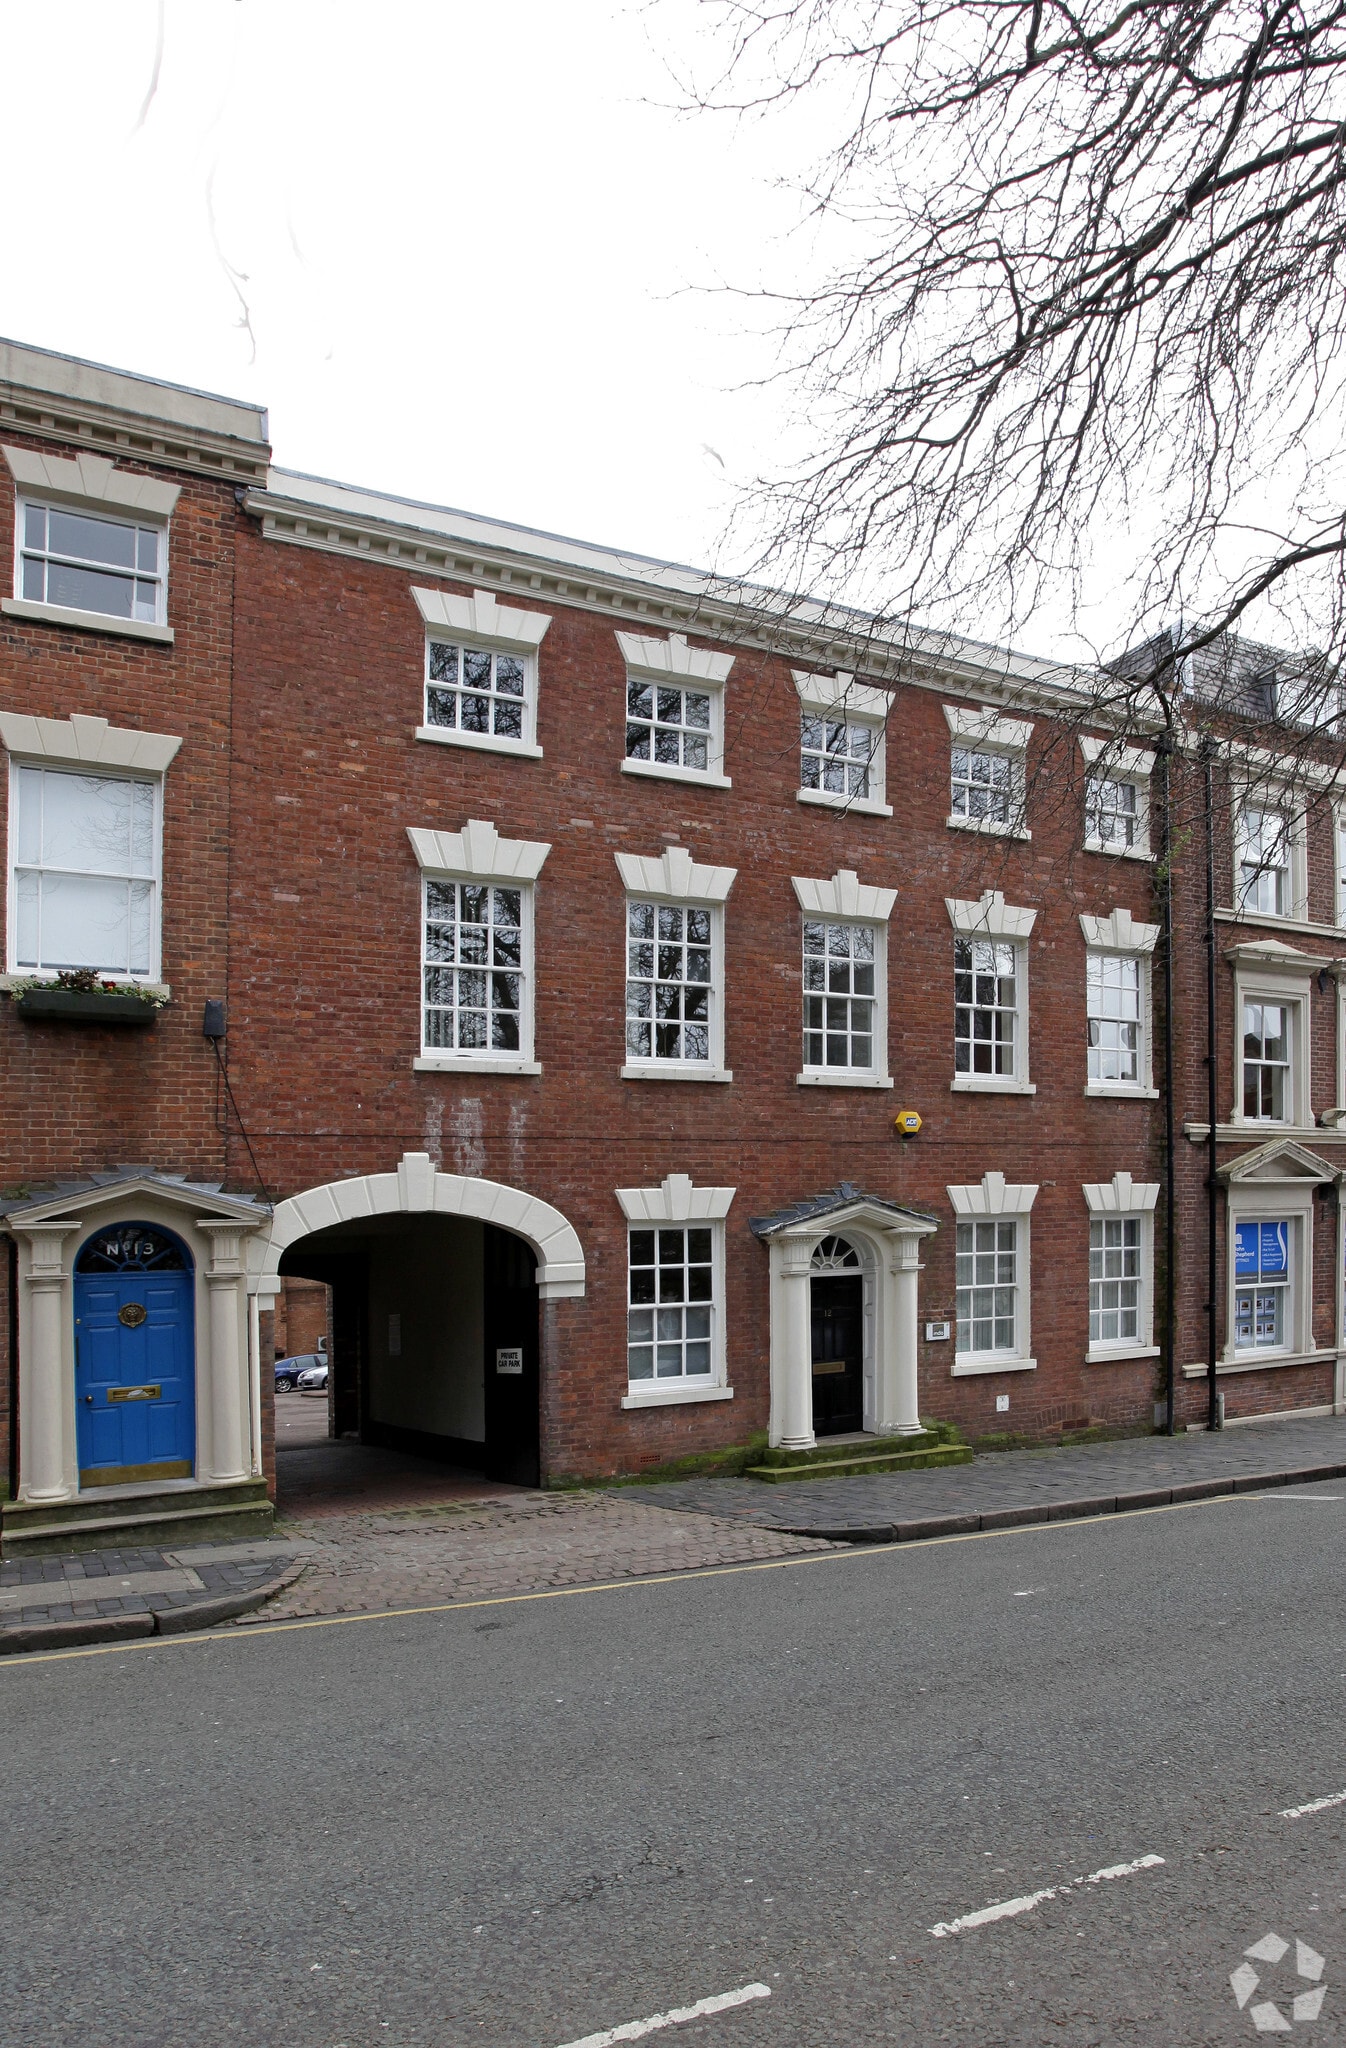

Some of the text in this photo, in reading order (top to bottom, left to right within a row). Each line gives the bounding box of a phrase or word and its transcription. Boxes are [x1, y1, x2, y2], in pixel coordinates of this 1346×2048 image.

[134, 1243, 155, 1255] 13
[500, 1352, 519, 1360] PRIVATE
[498, 1360, 521, 1368] CAR PARK
